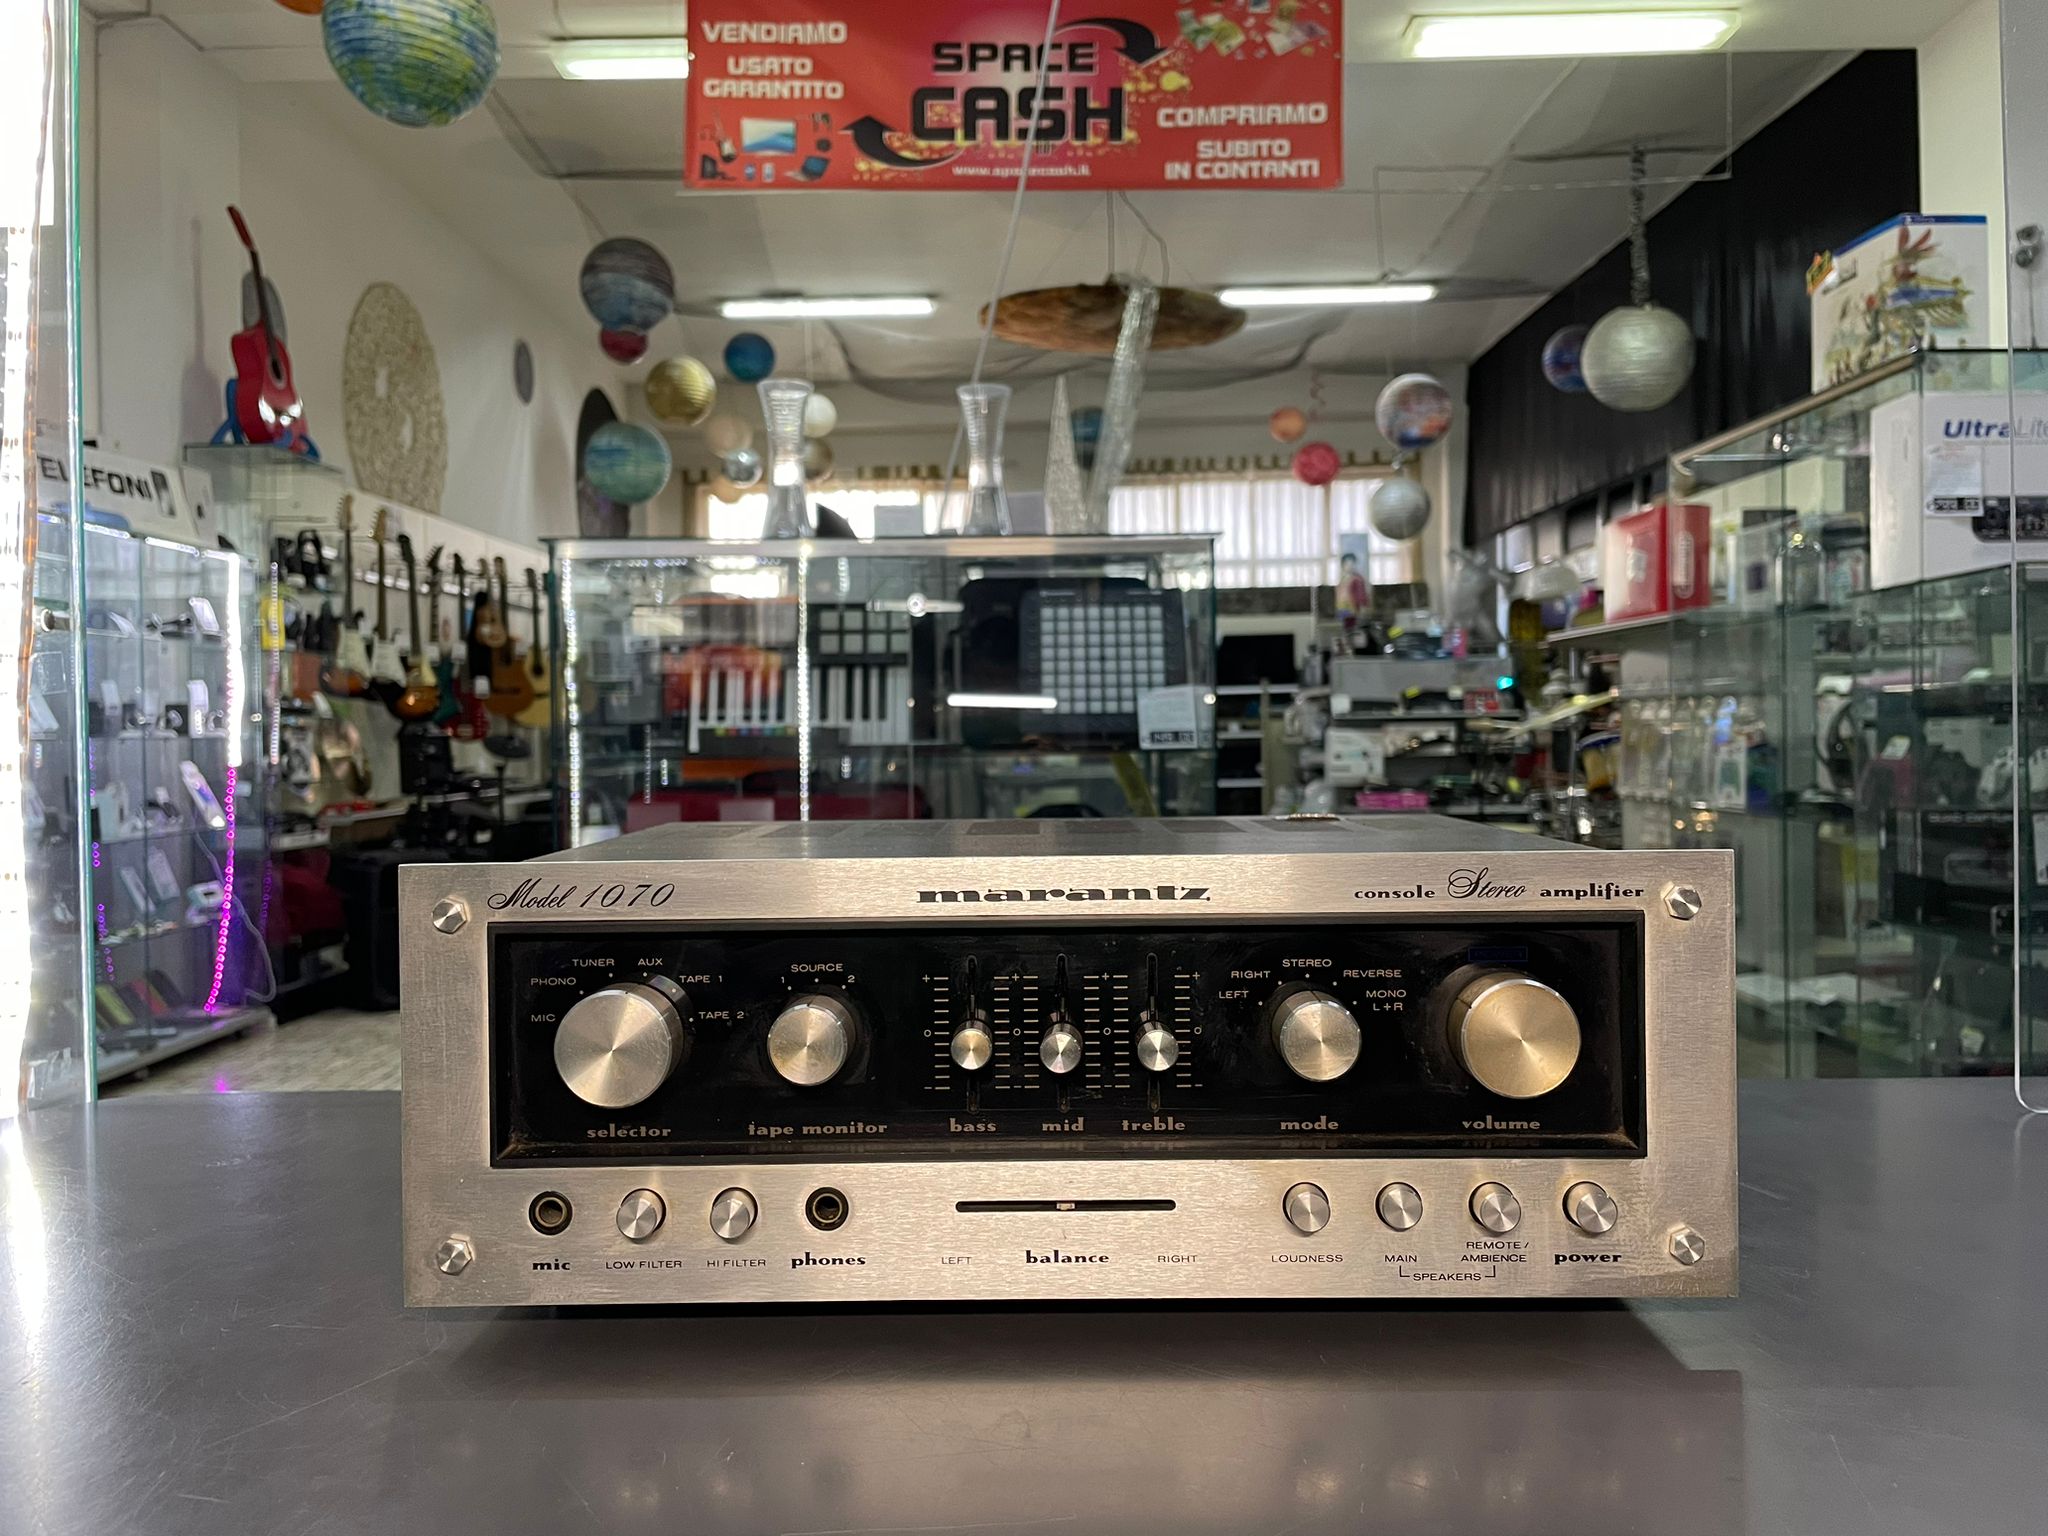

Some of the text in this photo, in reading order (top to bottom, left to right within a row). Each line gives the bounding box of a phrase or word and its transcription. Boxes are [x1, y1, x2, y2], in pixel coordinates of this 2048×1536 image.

[701, 21, 848, 44] VENDIAMO
[933, 42, 1095, 73] SPACE
[727, 56, 813, 75] USATO
[703, 79, 844, 99] GARANTITO
[912, 86, 1123, 141] CASH
[1157, 102, 1328, 128] COMPRIAMO
[1197, 139, 1290, 158] SUBITO
[1165, 160, 1319, 180] IN CONTANTI
[1354, 867, 1645, 900] console Stereo amplifier
[487, 877, 675, 910] Model 1070
[916, 886, 1211, 902] marantz
[572, 958, 615, 967] TUNER
[637, 958, 663, 966] AUX
[1282, 959, 1332, 967] STEREO
[790, 963, 844, 973] SOURCE
[1343, 969, 1402, 978] REVERSE
[679, 975, 724, 984] TAPE 1
[780, 976, 785, 984] 1
[847, 974, 856, 983] 2
[1231, 971, 1271, 979] RIGHT
[530, 977, 577, 986] PHONO
[1218, 991, 1249, 999] LEFT
[1365, 989, 1407, 998] MONO
[531, 1013, 556, 1022] MIC
[699, 1011, 745, 1019] TAPE 2
[949, 1118, 997, 1133] bass
[1042, 1117, 1084, 1131] mid
[1122, 1117, 1186, 1132] treble
[1280, 1115, 1339, 1131] mode
[1462, 1115, 1541, 1131] volume
[587, 1123, 672, 1139] selector
[748, 1121, 887, 1138] tape monitor
[791, 1252, 866, 1270] phones
[941, 1256, 971, 1265] LEFT
[1025, 1250, 1109, 1264] balance
[1157, 1254, 1197, 1263] RIGHT
[1271, 1255, 1344, 1263] LOUDNESS
[1384, 1255, 1418, 1263] MAIN
[1461, 1254, 1527, 1263] AMBIENCE
[1554, 1252, 1622, 1265] power
[532, 1259, 571, 1271] mic
[605, 1260, 682, 1270] LOW FILTER
[707, 1258, 766, 1268] HI FILTER
[1412, 1273, 1482, 1282] SPEAKERS
